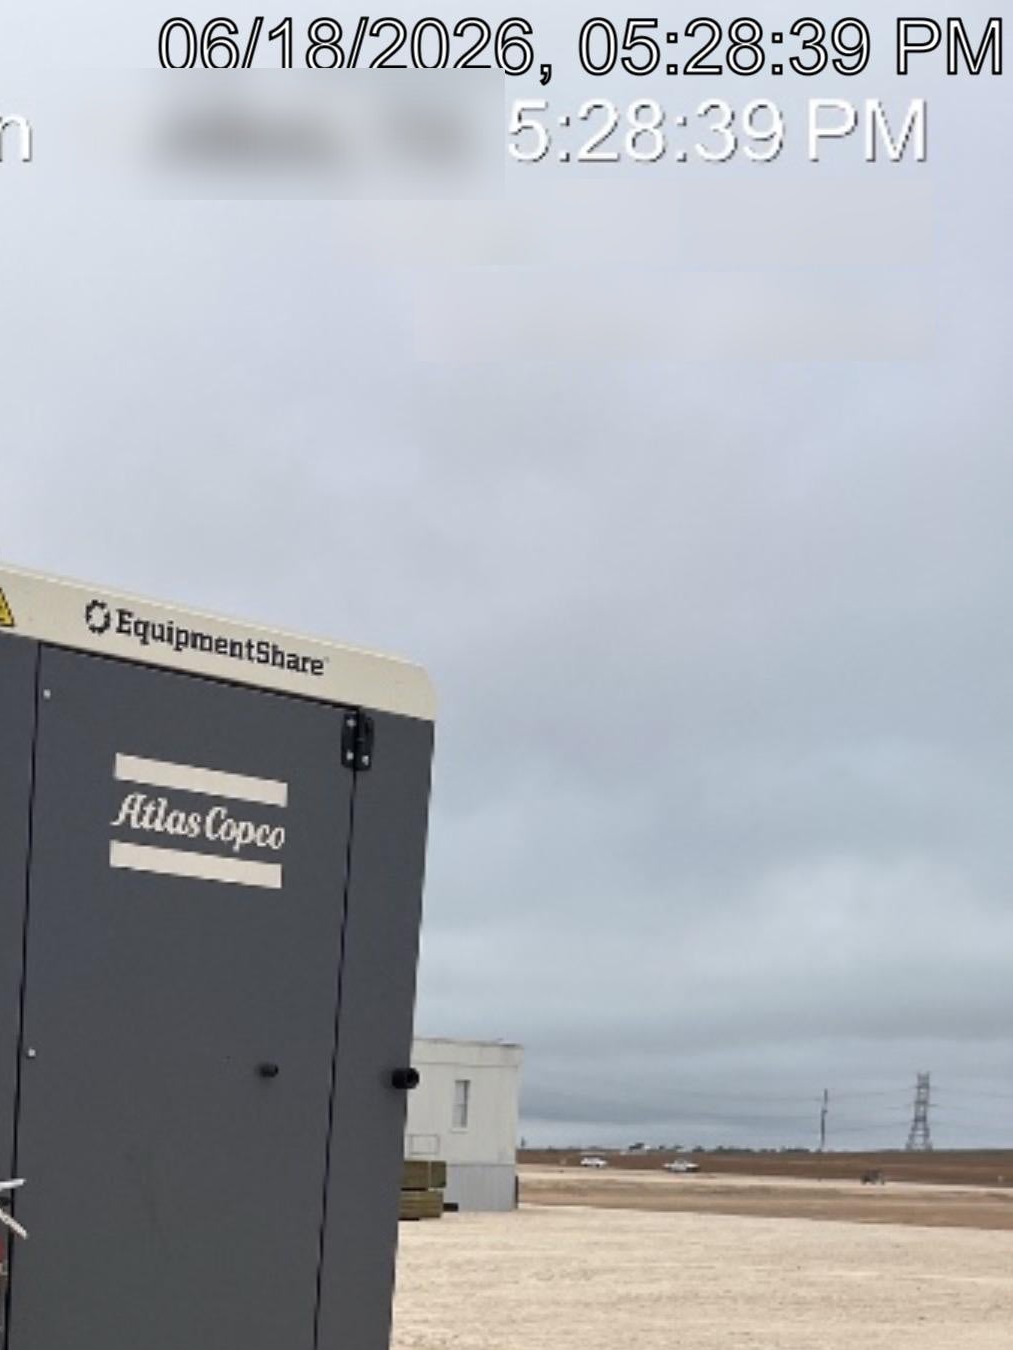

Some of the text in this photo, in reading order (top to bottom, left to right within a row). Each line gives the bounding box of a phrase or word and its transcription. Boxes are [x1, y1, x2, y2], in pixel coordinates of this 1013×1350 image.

[115, 608, 325, 676] EquipmentShare
[110, 792, 285, 852] Atlas Copco
